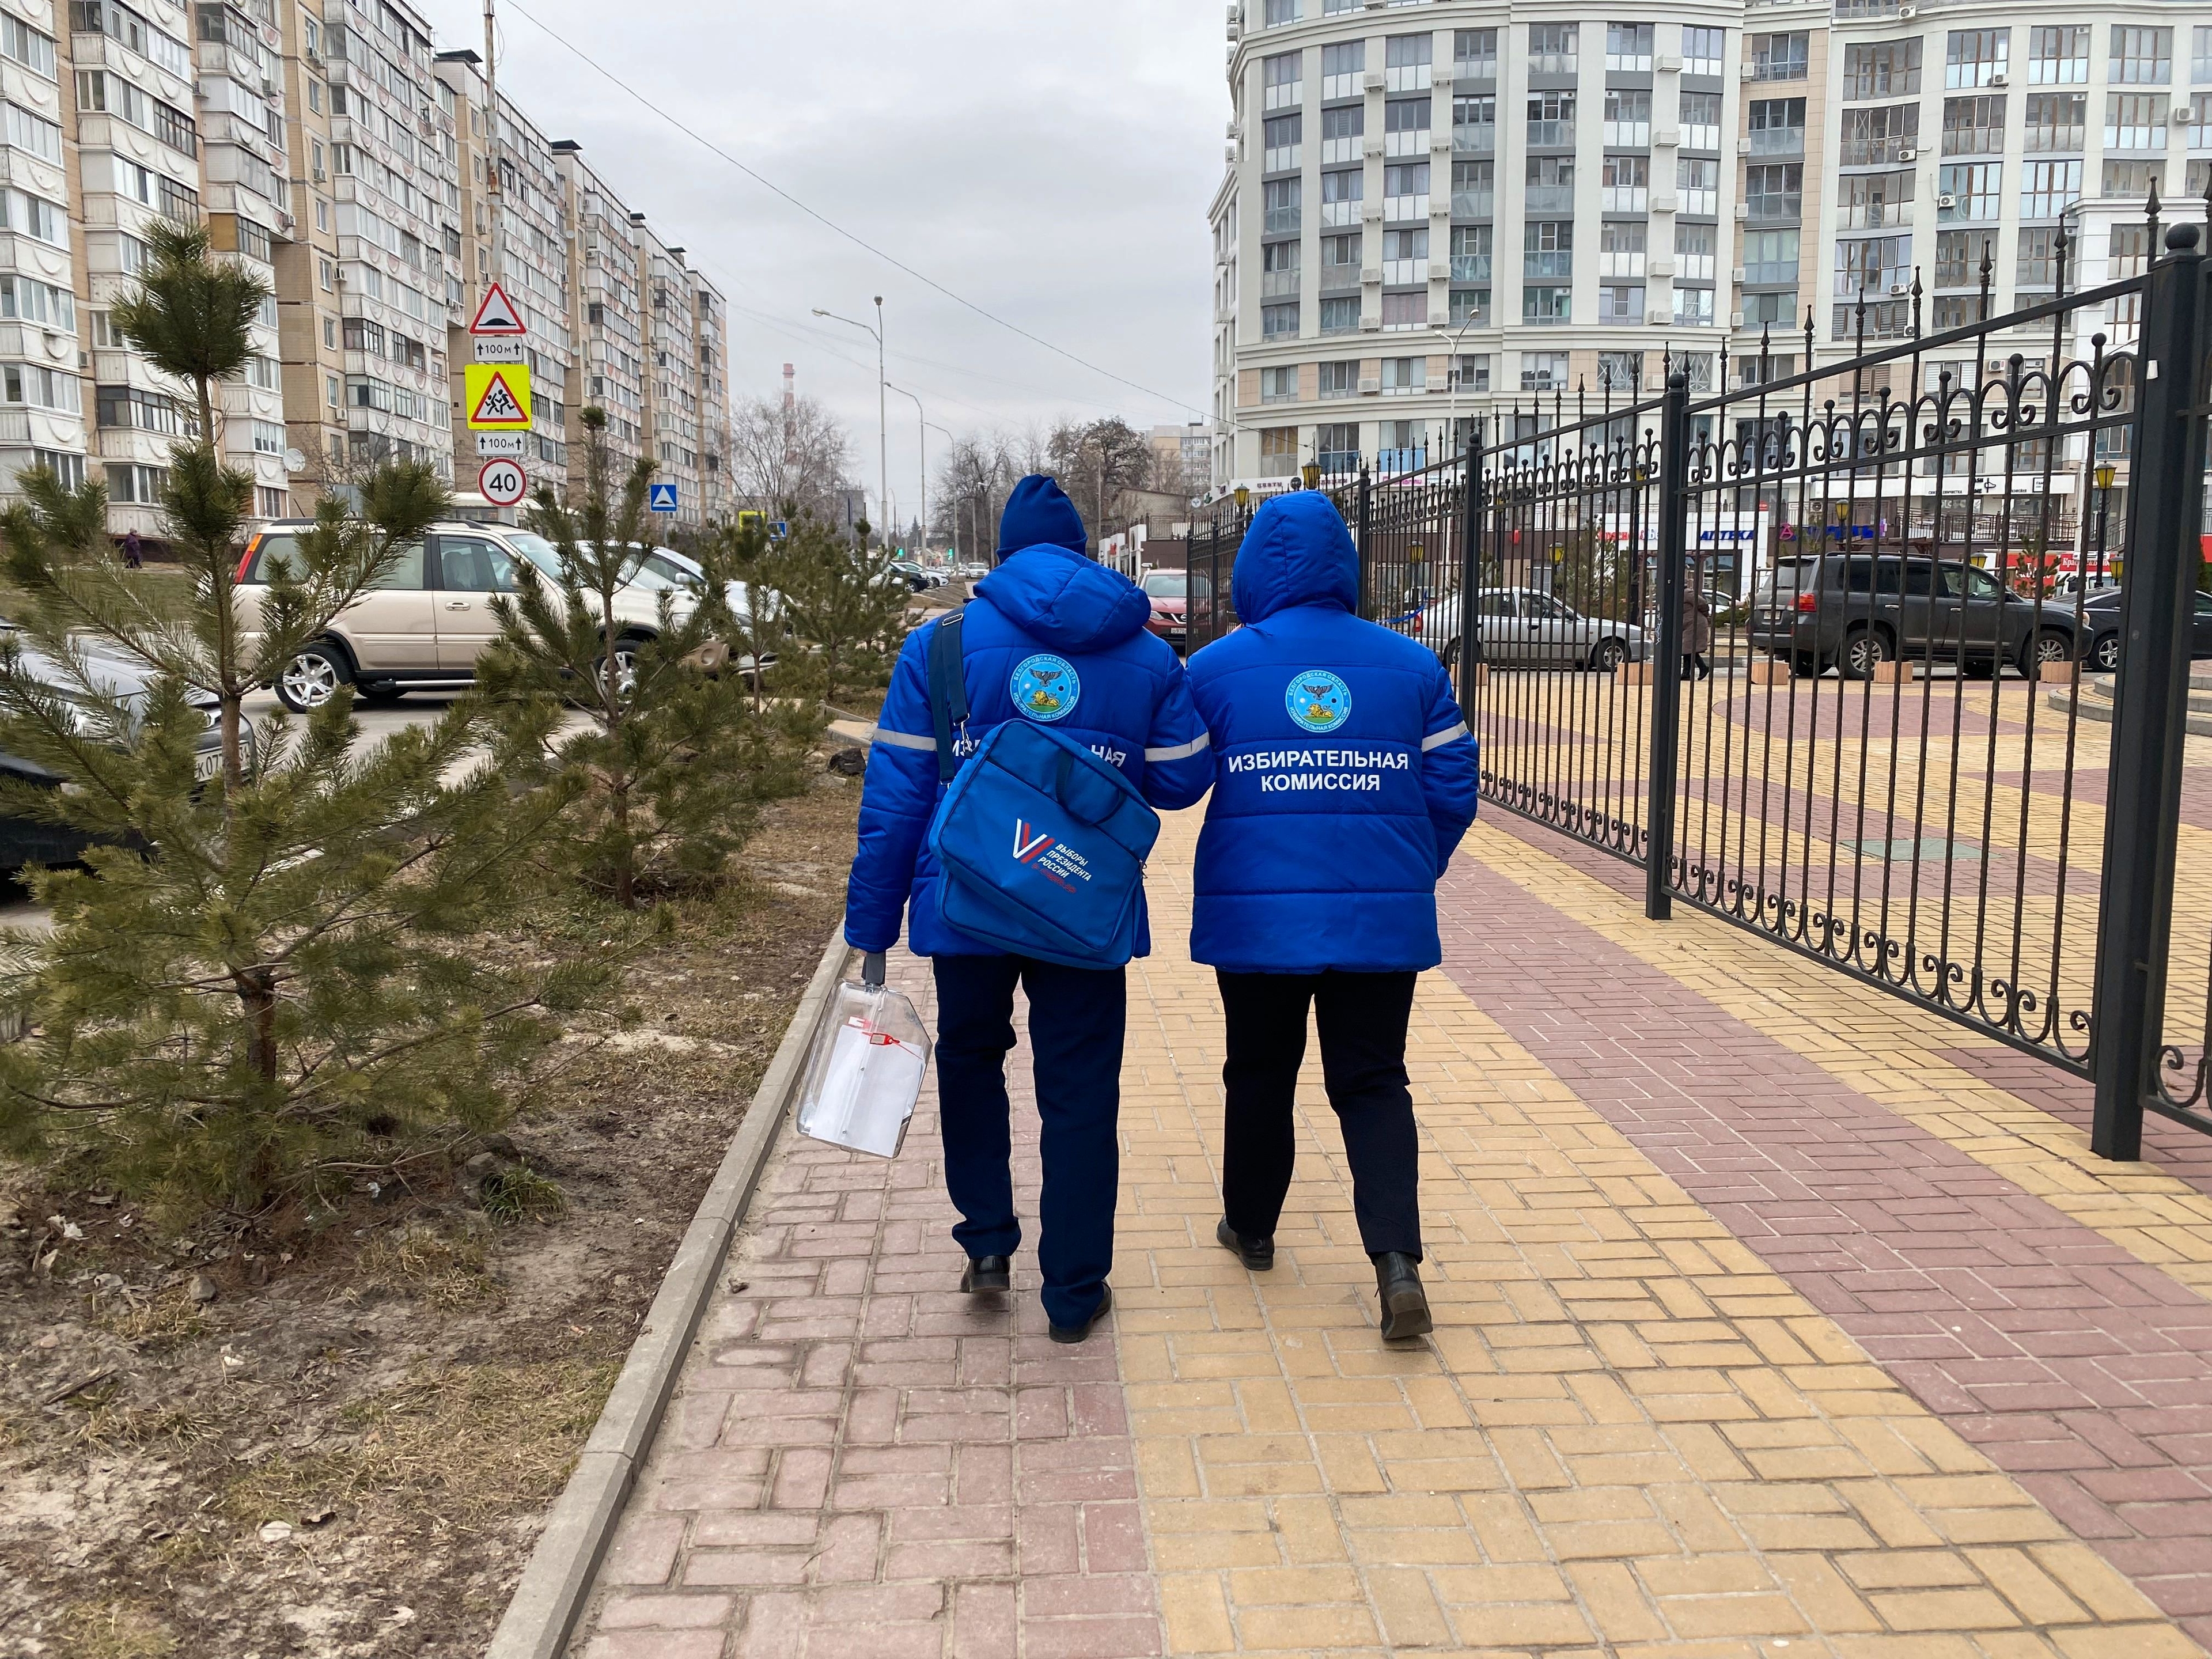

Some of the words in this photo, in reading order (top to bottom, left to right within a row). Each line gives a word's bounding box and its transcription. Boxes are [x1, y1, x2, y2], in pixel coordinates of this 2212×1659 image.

[489, 474, 516, 492] 40
[1014, 657, 1057, 680] БЕЛГОРОДСКАЯ
[1058, 660, 1077, 684] ОБЛАСТЬ
[1289, 672, 1326, 696] БЕЛГОРОДСКАЯ
[1328, 675, 1348, 696] ОБЛАСТЬ
[1013, 692, 1051, 719] ИЗБИРАТЕЛЬНАЯ
[1052, 696, 1075, 718] КОМИССИЯ
[1289, 706, 1328, 730] ИЗБИРАТЕЛЬНАЯ
[1328, 707, 1349, 729] КОМИССИЯ
[1228, 750, 1408, 772] ИЗБИРАТЕЛЬНАЯ
[1261, 774, 1380, 791] КОМИССИЯ
[1046, 850, 1092, 881] ПРЕЗИДЕНТА
[1055, 843, 1088, 866] ВЫБОРЫ
[1037, 856, 1070, 878] РОССИИ
